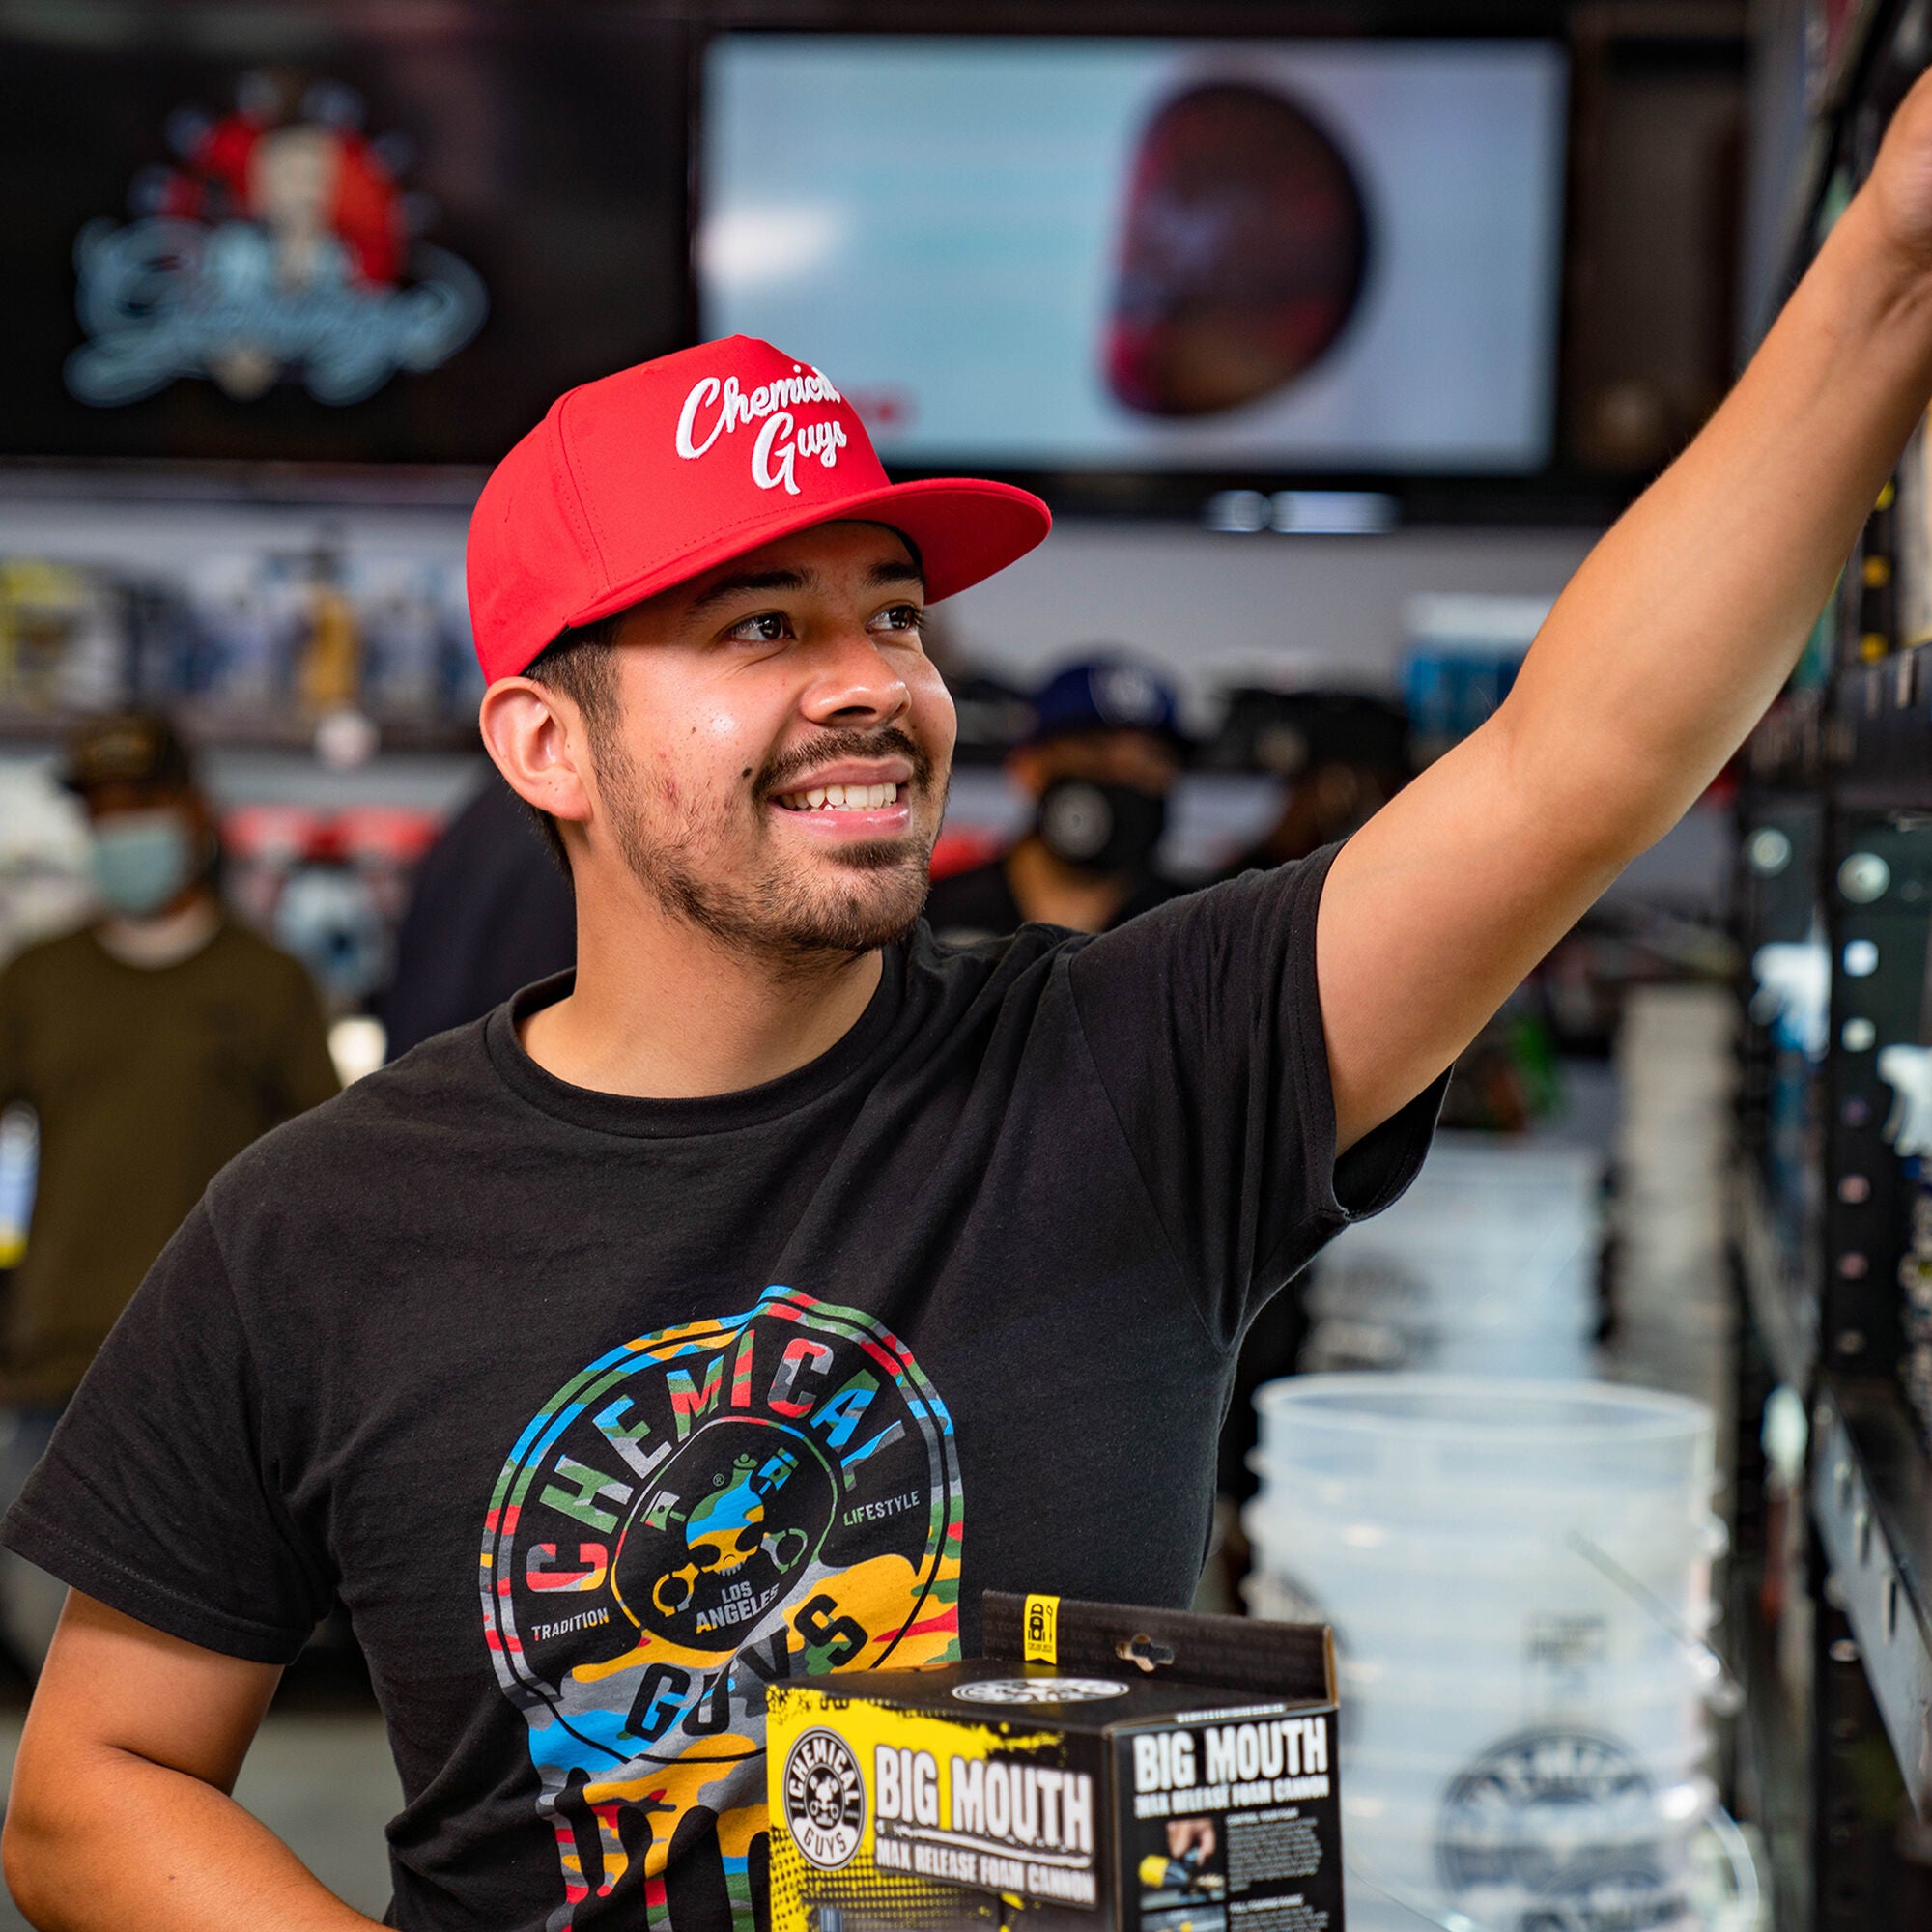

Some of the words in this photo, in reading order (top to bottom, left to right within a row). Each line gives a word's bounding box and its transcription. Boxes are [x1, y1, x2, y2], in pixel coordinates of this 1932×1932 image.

[752, 412, 847, 496] Guys
[526, 1329, 906, 1592] CHEMICAL
[843, 1490, 921, 1526] LIFESTYLE
[696, 1582, 780, 1634] ANGELES
[721, 1580, 753, 1604] LOS
[531, 1607, 610, 1641] TRADITION
[625, 1594, 868, 1742] GUYS
[789, 1738, 860, 1805] CHEMICAL
[1133, 1730, 1196, 1794] BIG
[1205, 1717, 1328, 1785] MOUTH
[875, 1744, 939, 1826] BIG
[952, 1755, 1094, 1853] MOUTH
[804, 1827, 847, 1859] GUYS
[876, 1837, 911, 1871] MAX
[914, 1846, 978, 1883] RELEASE
[980, 1856, 1025, 1891] FOAM
